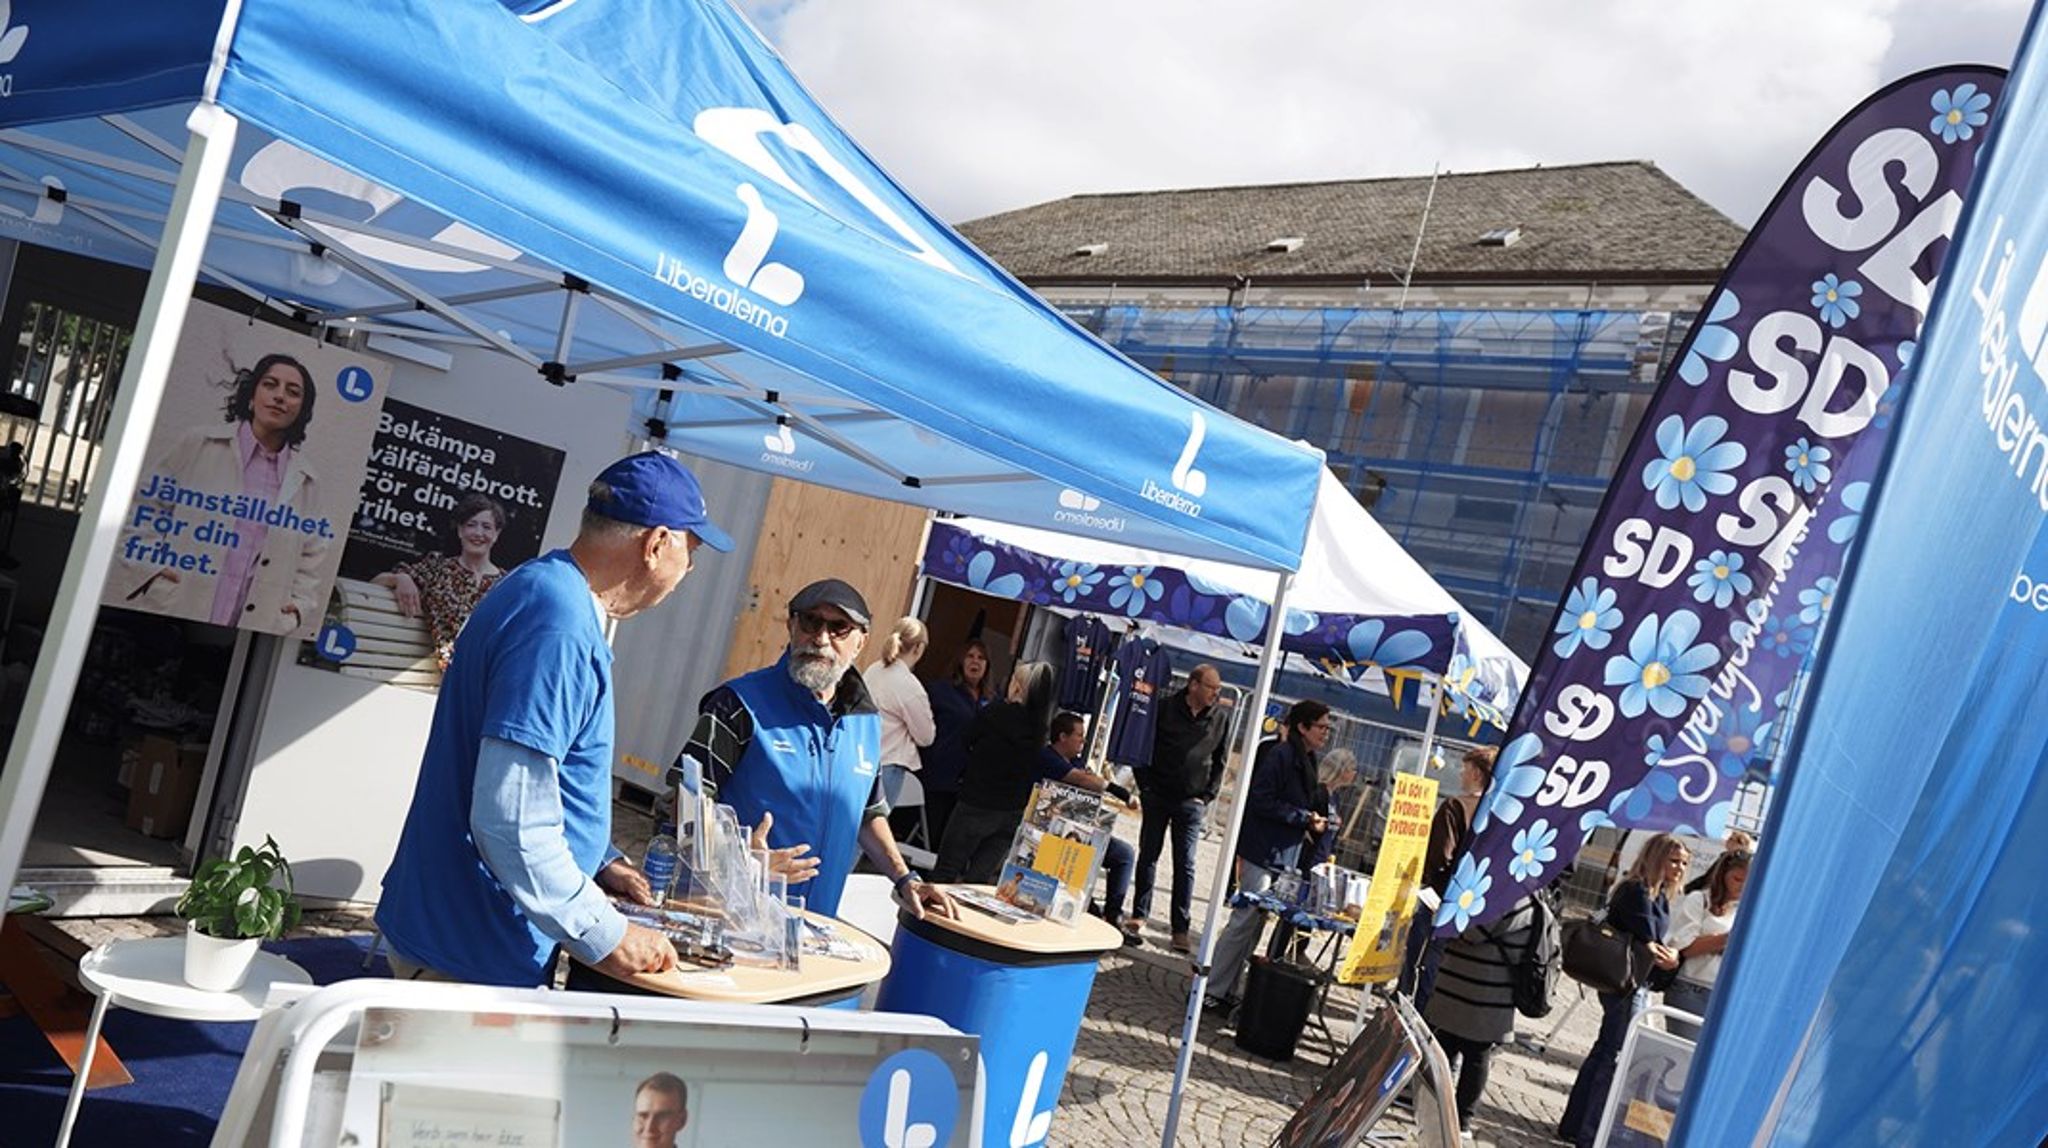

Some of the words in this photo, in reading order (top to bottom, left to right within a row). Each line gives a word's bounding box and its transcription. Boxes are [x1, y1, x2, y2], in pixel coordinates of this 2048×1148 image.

[654, 252, 789, 338] Liberalerna
[1727, 311, 1890, 438] SD
[377, 412, 496, 465] Bekämpa
[369, 444, 543, 509] välfärdsbrott.
[414, 483, 458, 510] din
[1139, 479, 1201, 517] Liberalerna
[133, 505, 188, 536] För
[194, 520, 240, 549] din
[140, 475, 335, 539] Jämställdhet.
[125, 536, 218, 575] frihet.
[1603, 518, 1694, 589] SD
[1544, 683, 1614, 741] SD
[1536, 755, 1611, 807] SD
